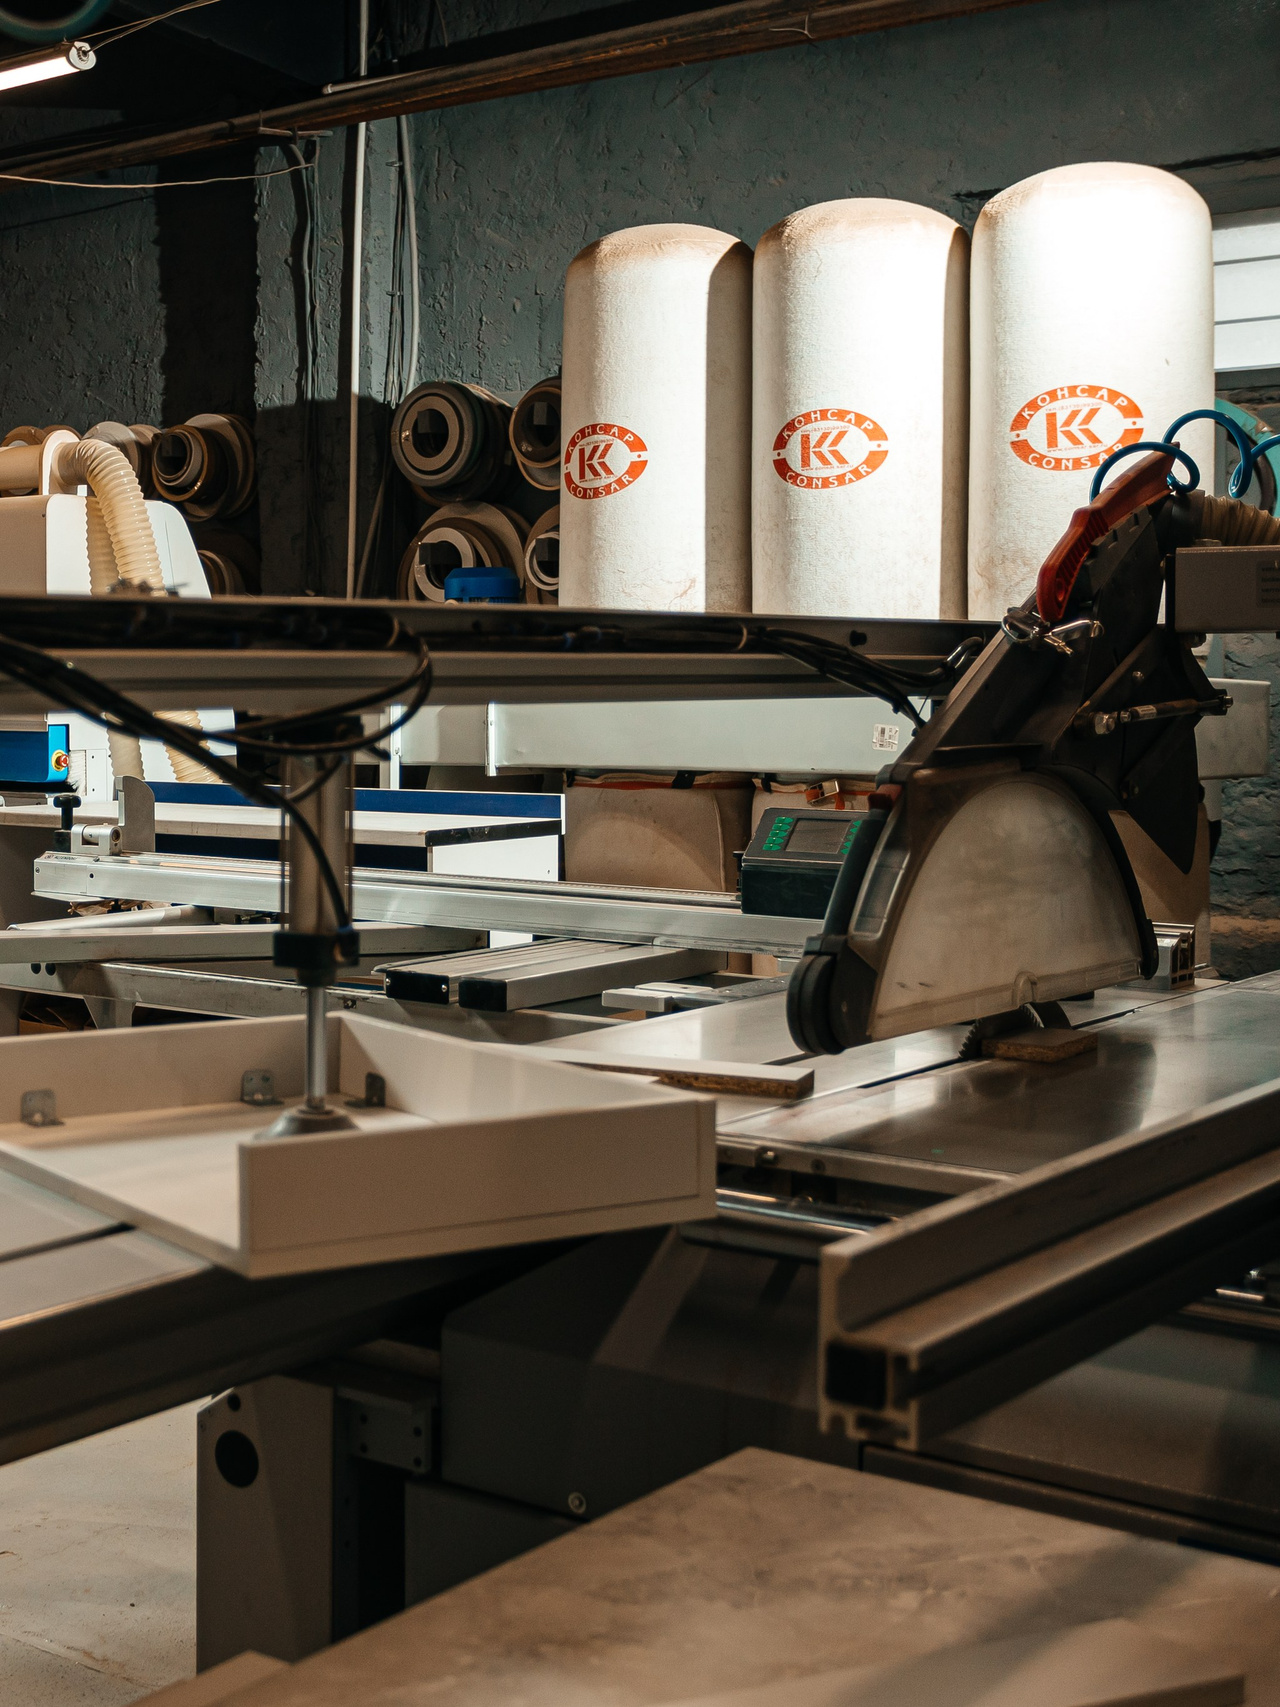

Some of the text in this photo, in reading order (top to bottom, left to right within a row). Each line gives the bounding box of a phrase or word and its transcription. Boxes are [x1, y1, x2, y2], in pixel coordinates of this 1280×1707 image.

[1022, 385, 1128, 420] КОНСАР
[568, 424, 634, 454] КОНСАР
[782, 409, 874, 440] КОНСАР
[570, 474, 634, 498] CONSAR
[786, 464, 872, 488] CONSAR
